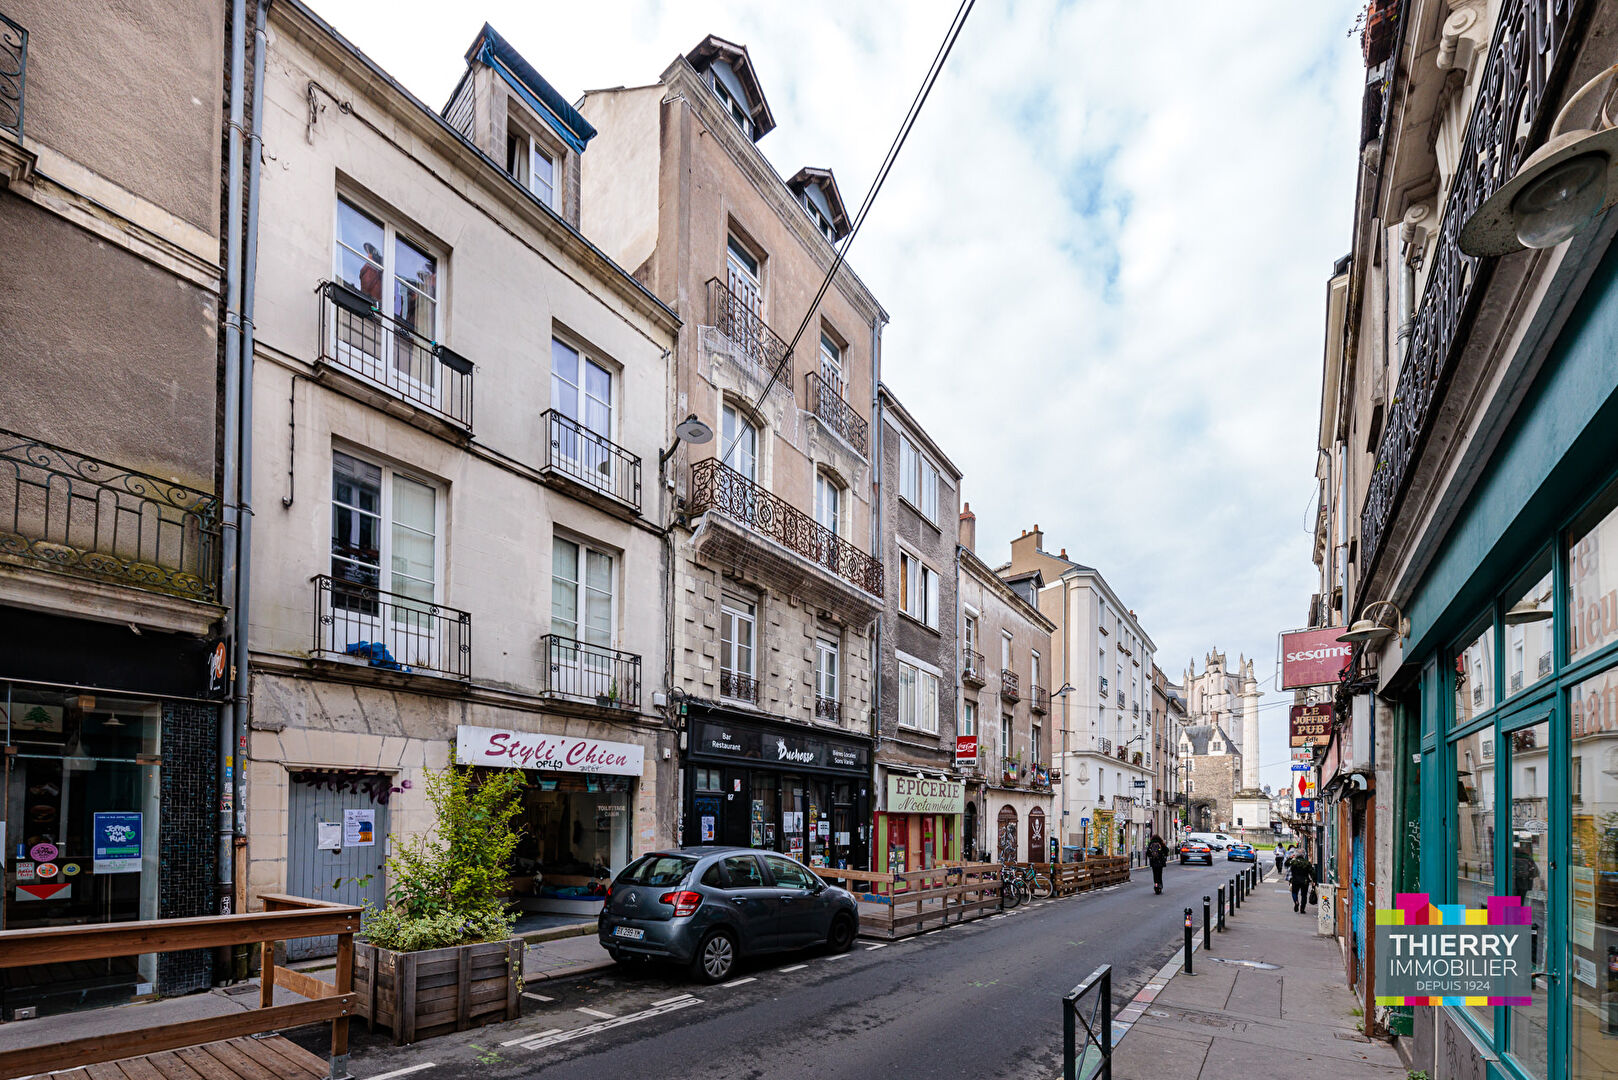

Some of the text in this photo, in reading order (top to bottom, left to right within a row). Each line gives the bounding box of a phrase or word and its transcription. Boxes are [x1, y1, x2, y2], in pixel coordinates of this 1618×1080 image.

[1286, 645, 1352, 663] sesame
[1302, 706, 1320, 716] LE
[1293, 715, 1330, 725] JOFFRE
[1297, 724, 1325, 735] PUB
[722, 732, 732, 741] Bar
[711, 740, 741, 751] Restaurant
[777, 745, 815, 763] Duchesse
[896, 777, 960, 799] ÉPICERIE
